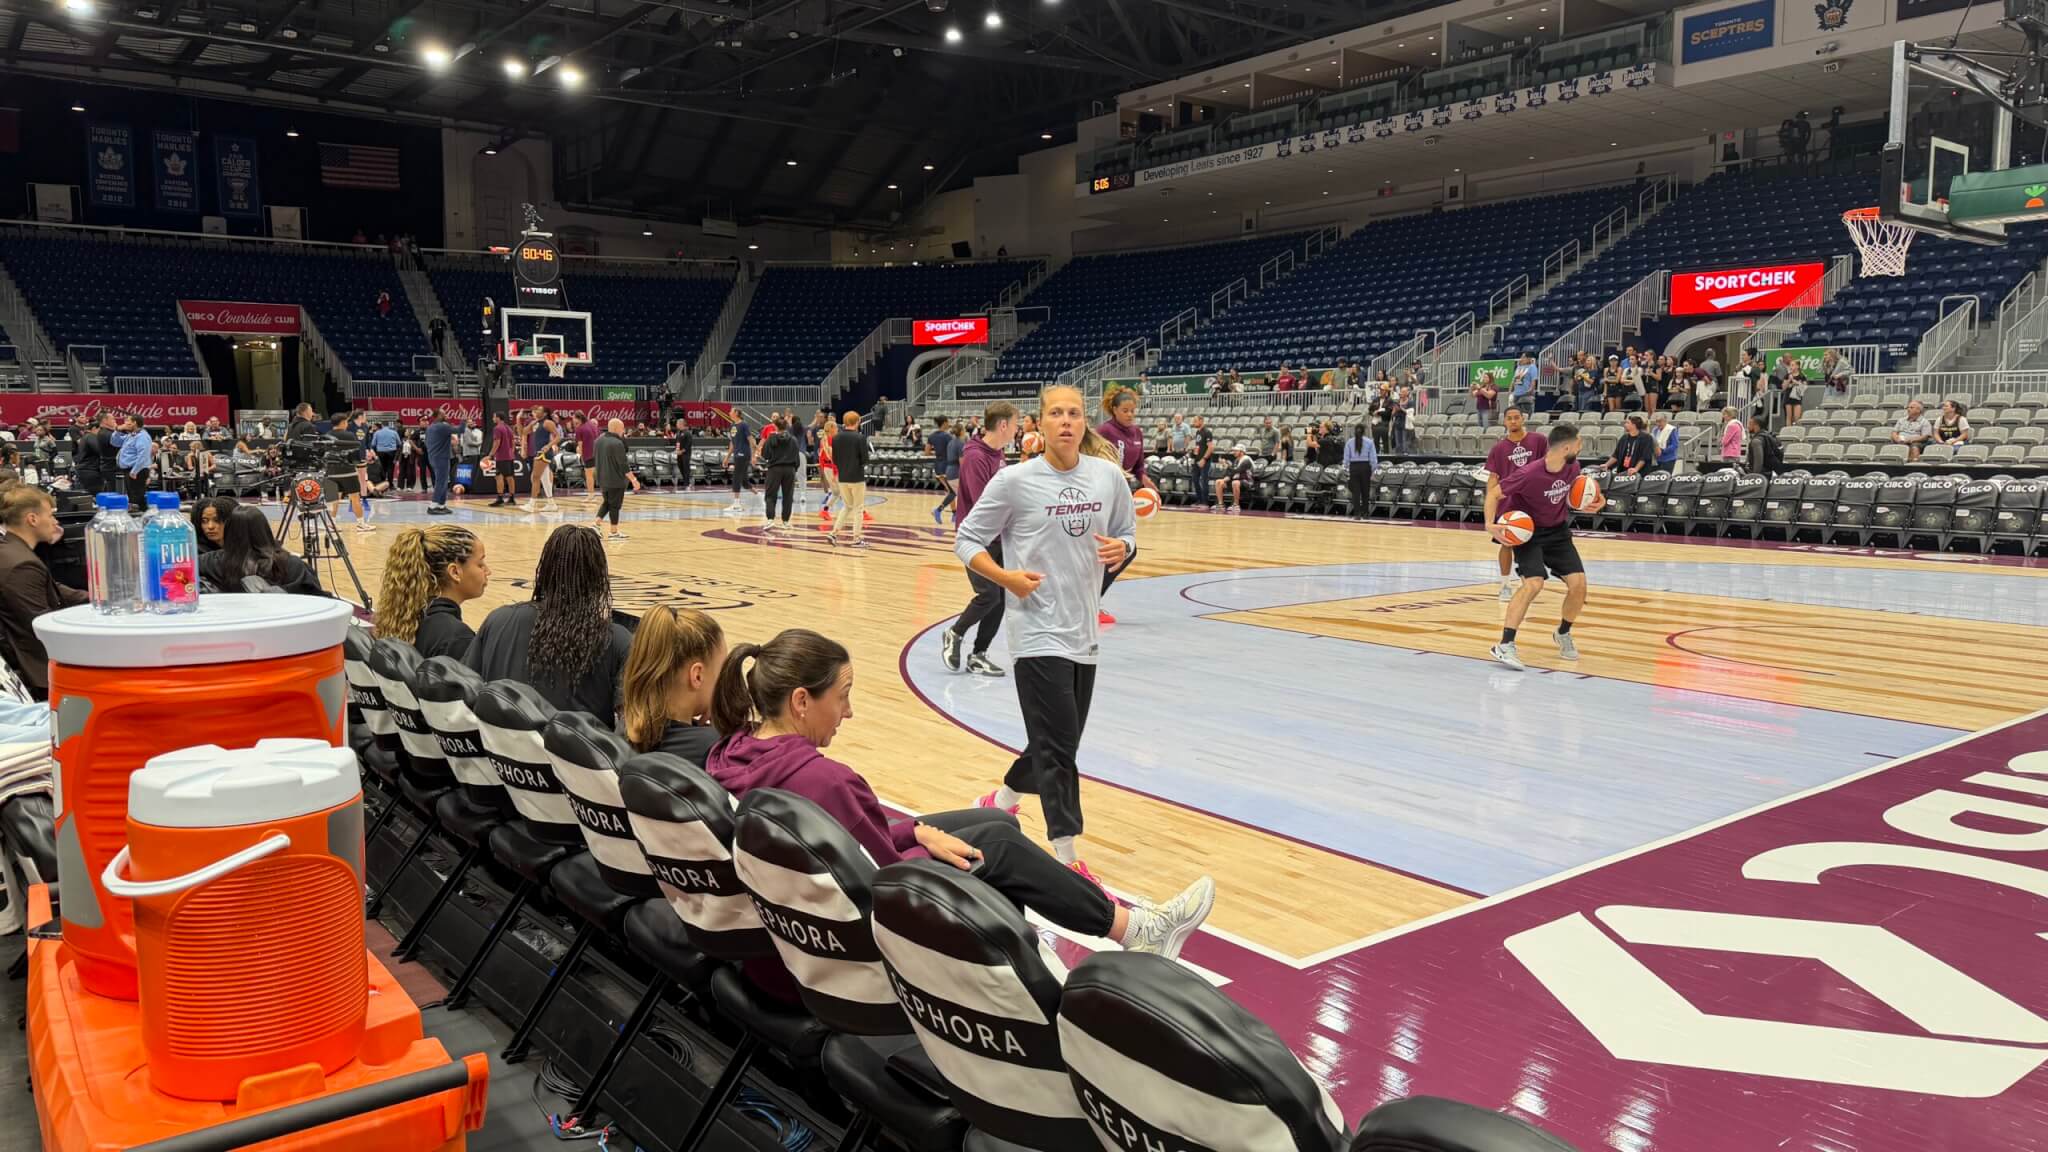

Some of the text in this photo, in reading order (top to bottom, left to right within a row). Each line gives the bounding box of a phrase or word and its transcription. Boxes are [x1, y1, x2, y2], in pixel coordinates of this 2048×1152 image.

[1691, 18, 1765, 45] SCEPTRES
[91, 127, 128, 137] TORONTO
[91, 135, 128, 145] MARLIES
[156, 133, 192, 144] TORONTO
[158, 143, 192, 152] MARLIES
[1144, 164, 1189, 181] Developing
[1216, 154, 1240, 166] since
[1243, 147, 1263, 160] 1927
[522, 248, 553, 260] 80:46
[217, 310, 272, 325] Courtside
[274, 316, 295, 324] CLUB
[1151, 382, 1187, 395] stacart
[607, 391, 633, 400] Sprite
[167, 406, 198, 416] CLUB
[1045, 501, 1103, 516] TEMPO
[161, 543, 191, 564] FIJI
[757, 900, 847, 954] EPHORA
